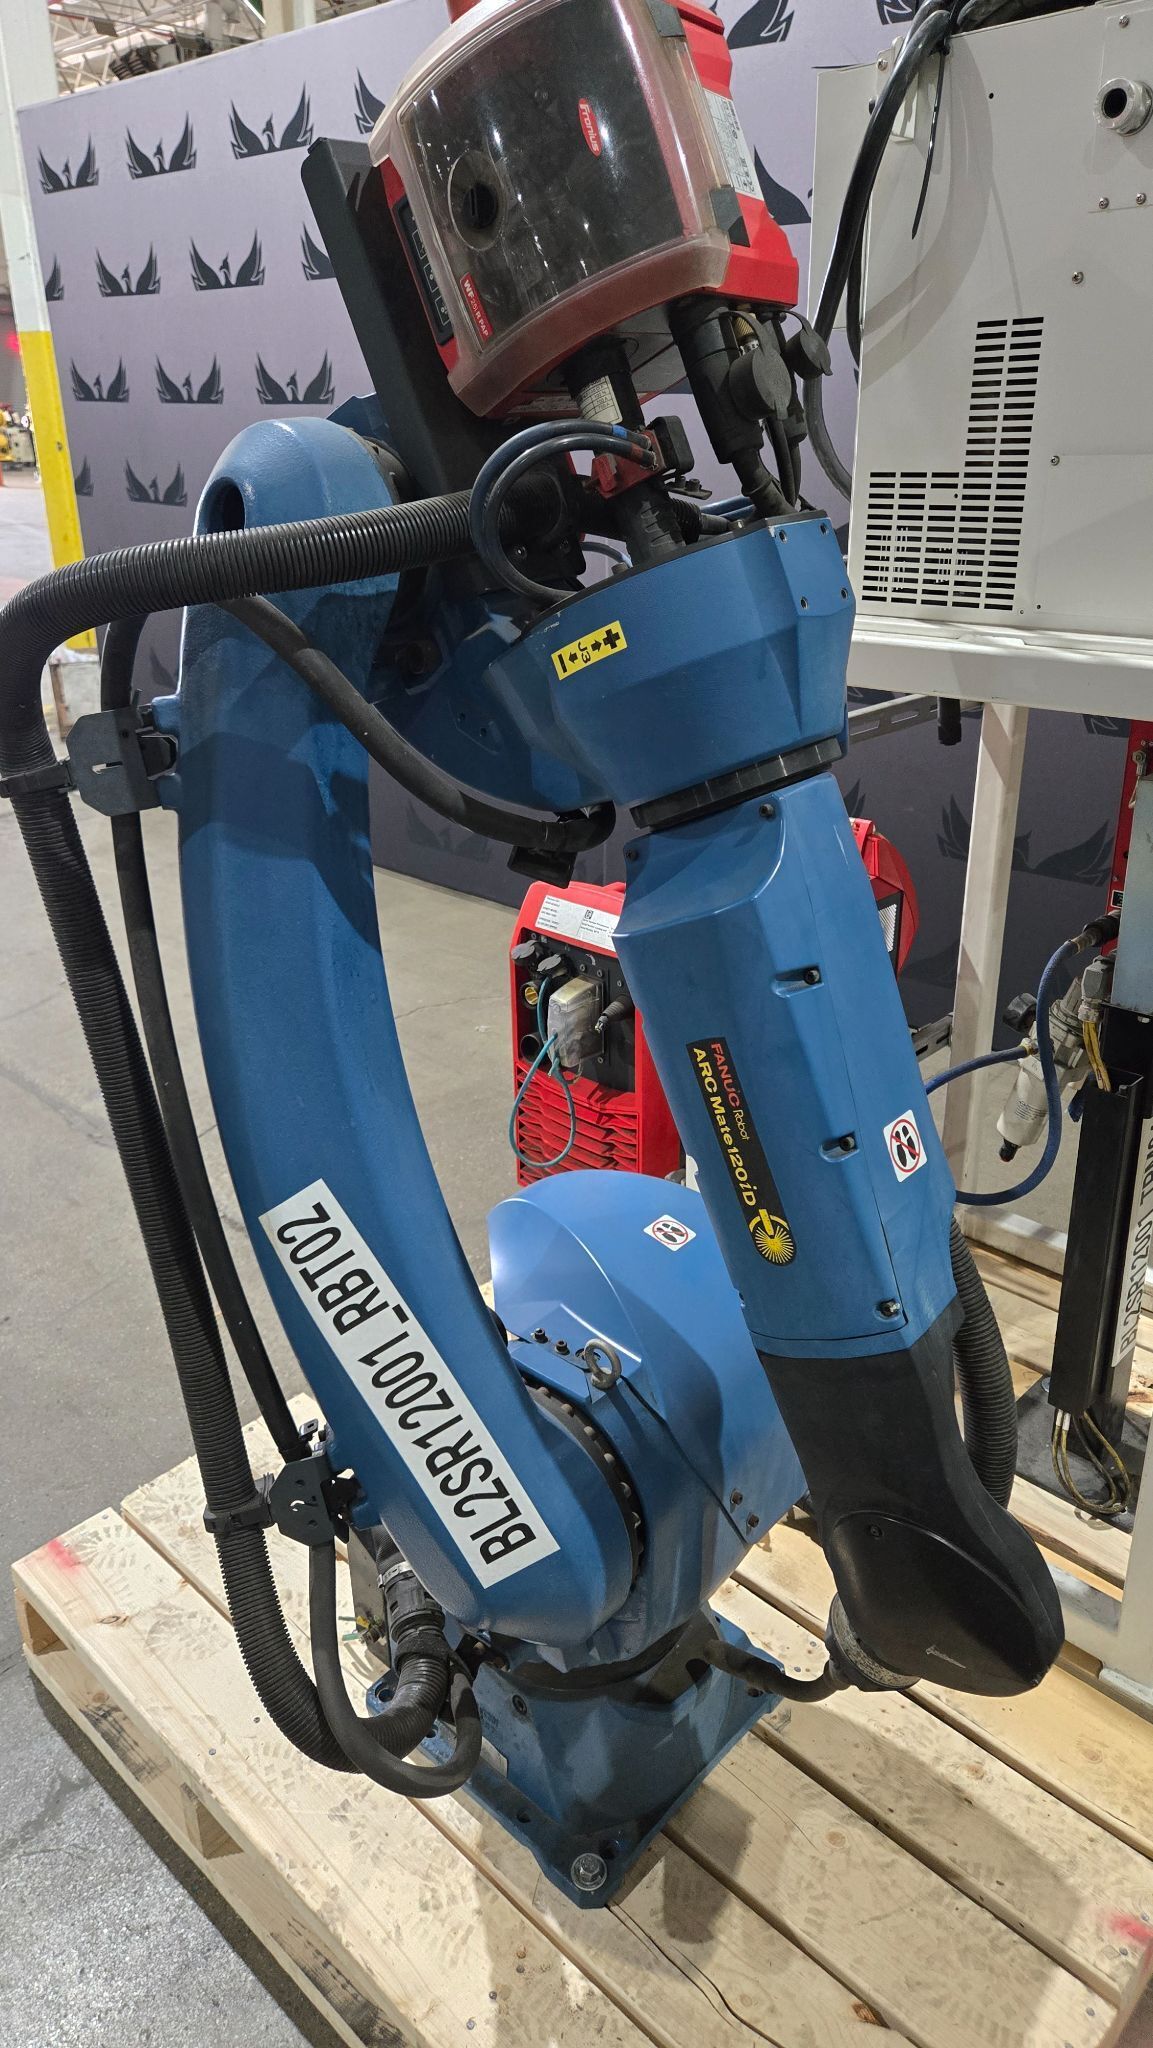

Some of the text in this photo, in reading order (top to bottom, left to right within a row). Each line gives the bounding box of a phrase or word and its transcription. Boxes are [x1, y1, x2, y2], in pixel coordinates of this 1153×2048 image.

[579, 103, 600, 152] Fronius
[464, 279, 475, 298] WF
[479, 319, 489, 336] PAP
[577, 641, 591, 663] J3
[693, 1048, 718, 1093] ARC
[710, 1043, 750, 1141] FANUC Robot
[276, 1202, 537, 1565] BL2SR12001_RBT02
